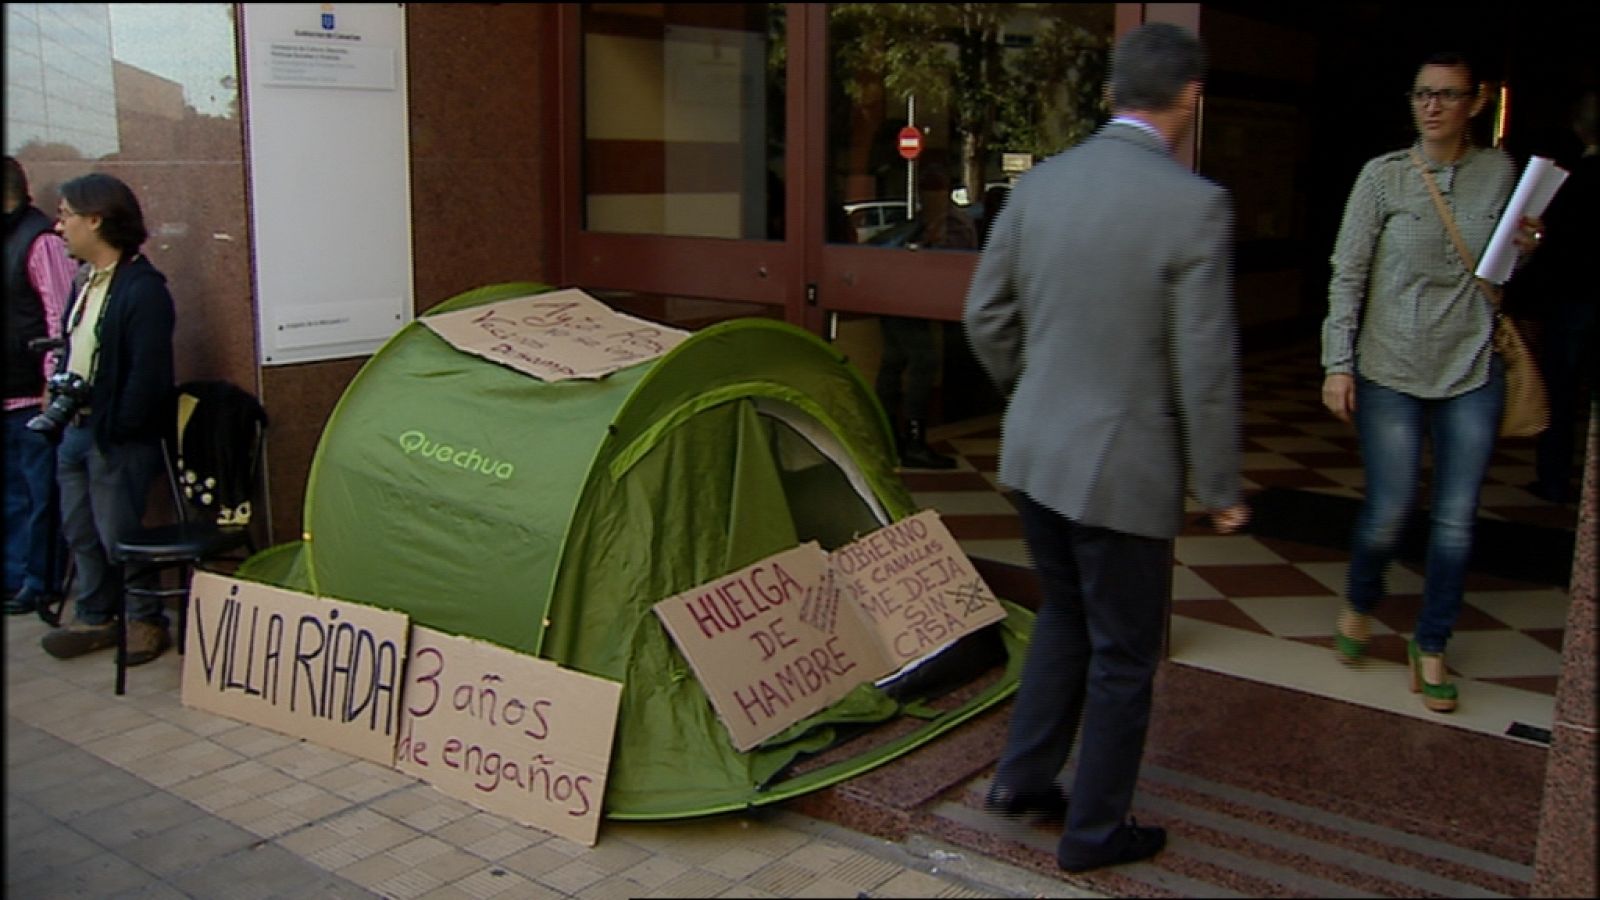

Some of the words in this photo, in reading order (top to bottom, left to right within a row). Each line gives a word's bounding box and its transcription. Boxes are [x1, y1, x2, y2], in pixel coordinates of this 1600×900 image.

[399, 429, 515, 480] Quechua
[860, 587, 901, 619] ME
[898, 556, 966, 602] DEJA
[871, 539, 944, 584] CANALLAS
[686, 563, 803, 640] HUELGA
[903, 591, 949, 629] SIN
[750, 617, 799, 661] DE
[893, 613, 966, 658] CASA
[408, 647, 444, 717] 3
[453, 674, 552, 740] años
[733, 636, 857, 726] HAMBRE
[398, 718, 429, 767] de
[442, 739, 592, 817] engaños
